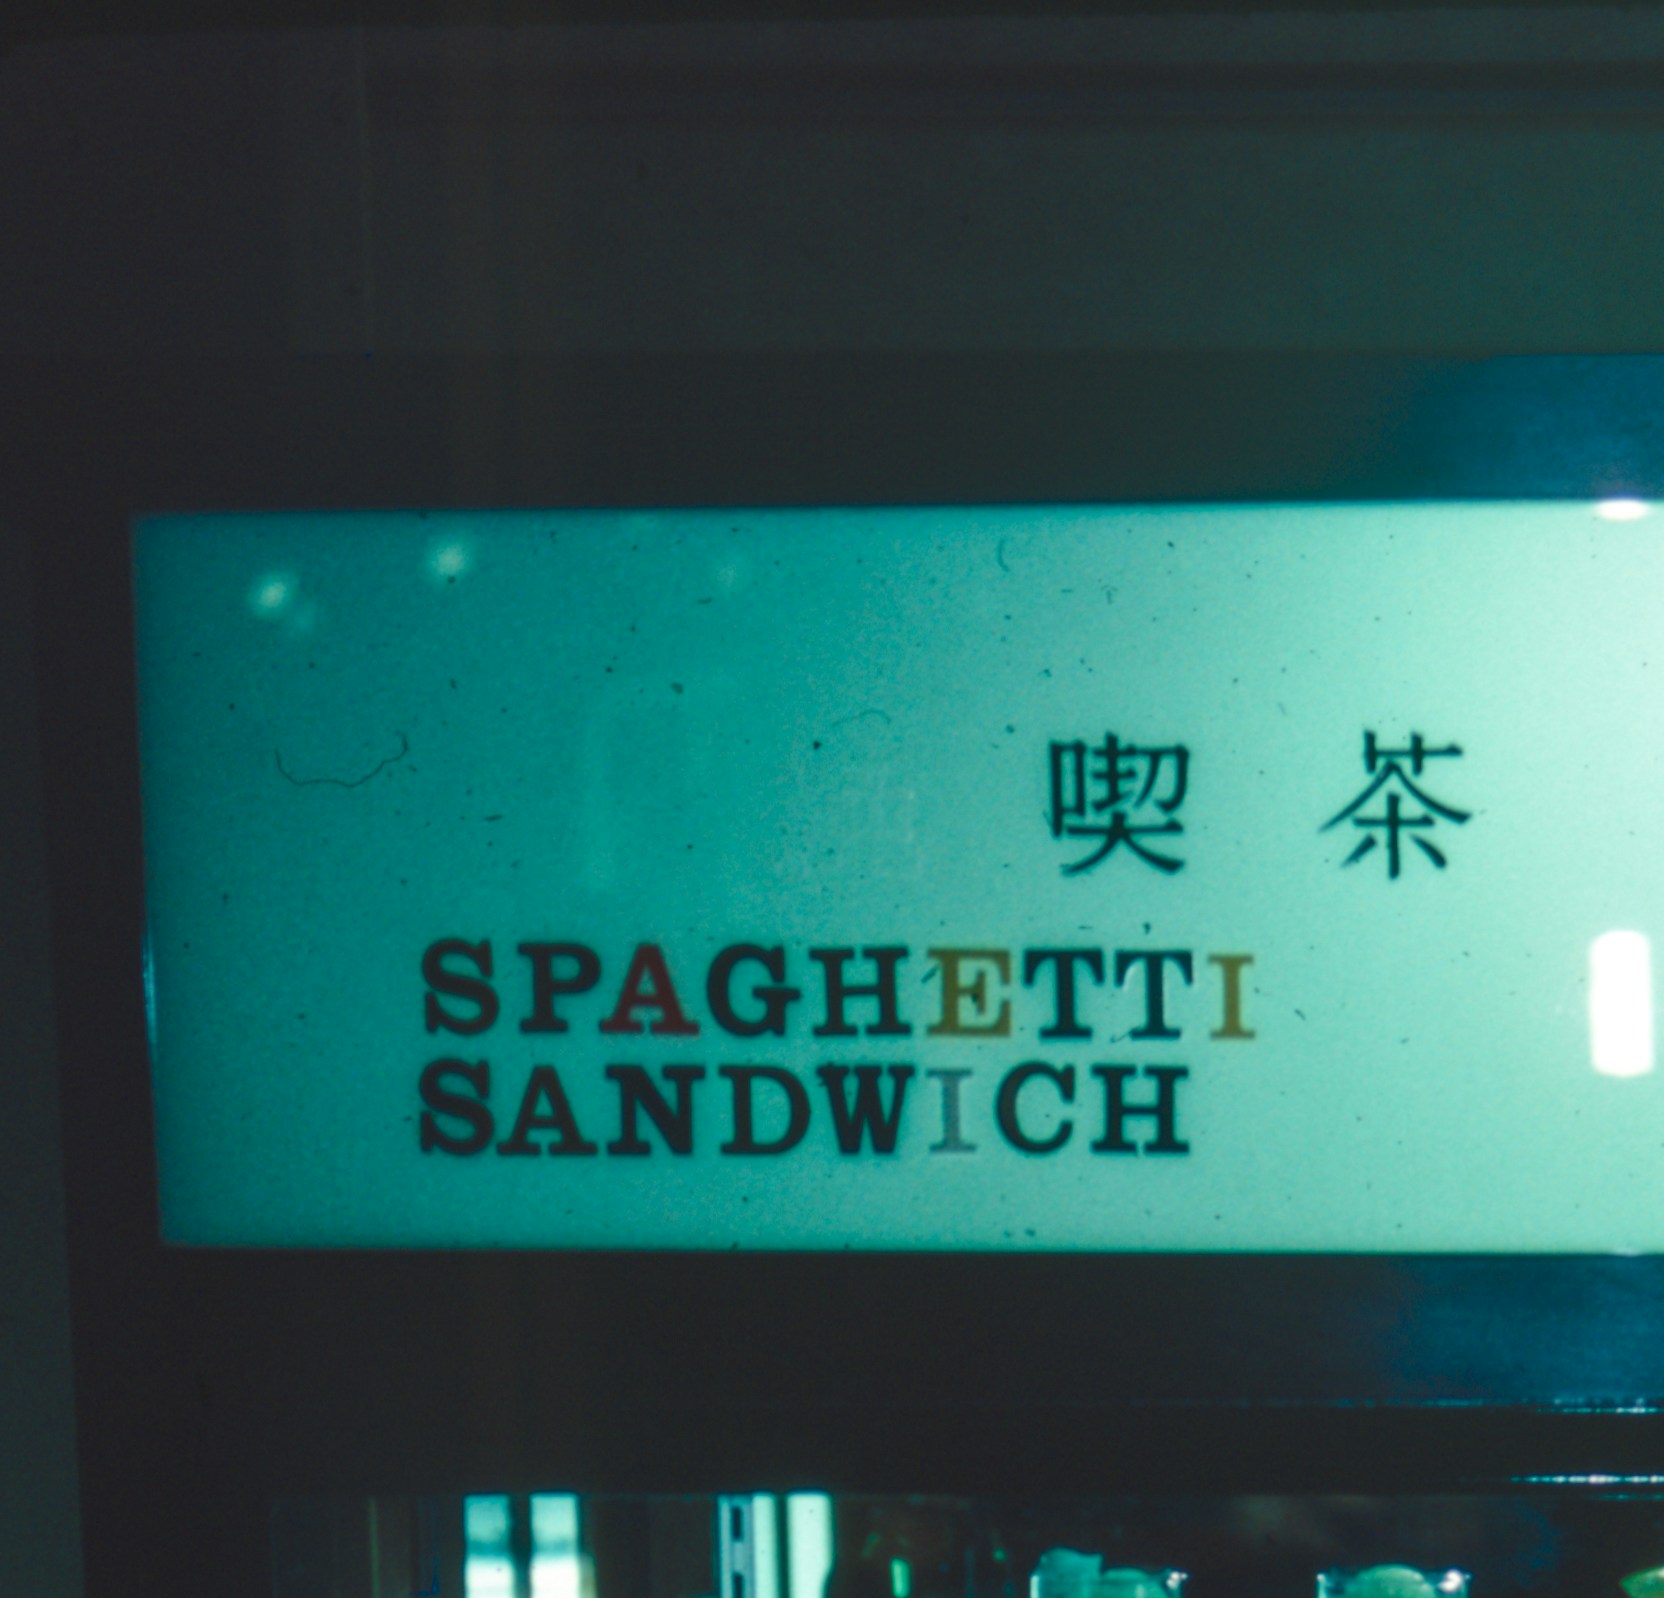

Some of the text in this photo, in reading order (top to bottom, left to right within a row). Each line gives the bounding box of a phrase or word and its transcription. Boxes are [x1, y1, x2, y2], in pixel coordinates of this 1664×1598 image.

[1047, 731, 1473, 880] 喫茶
[420, 936, 1256, 1042] SPAGHETTI
[418, 1056, 1191, 1157] SANDWICH
